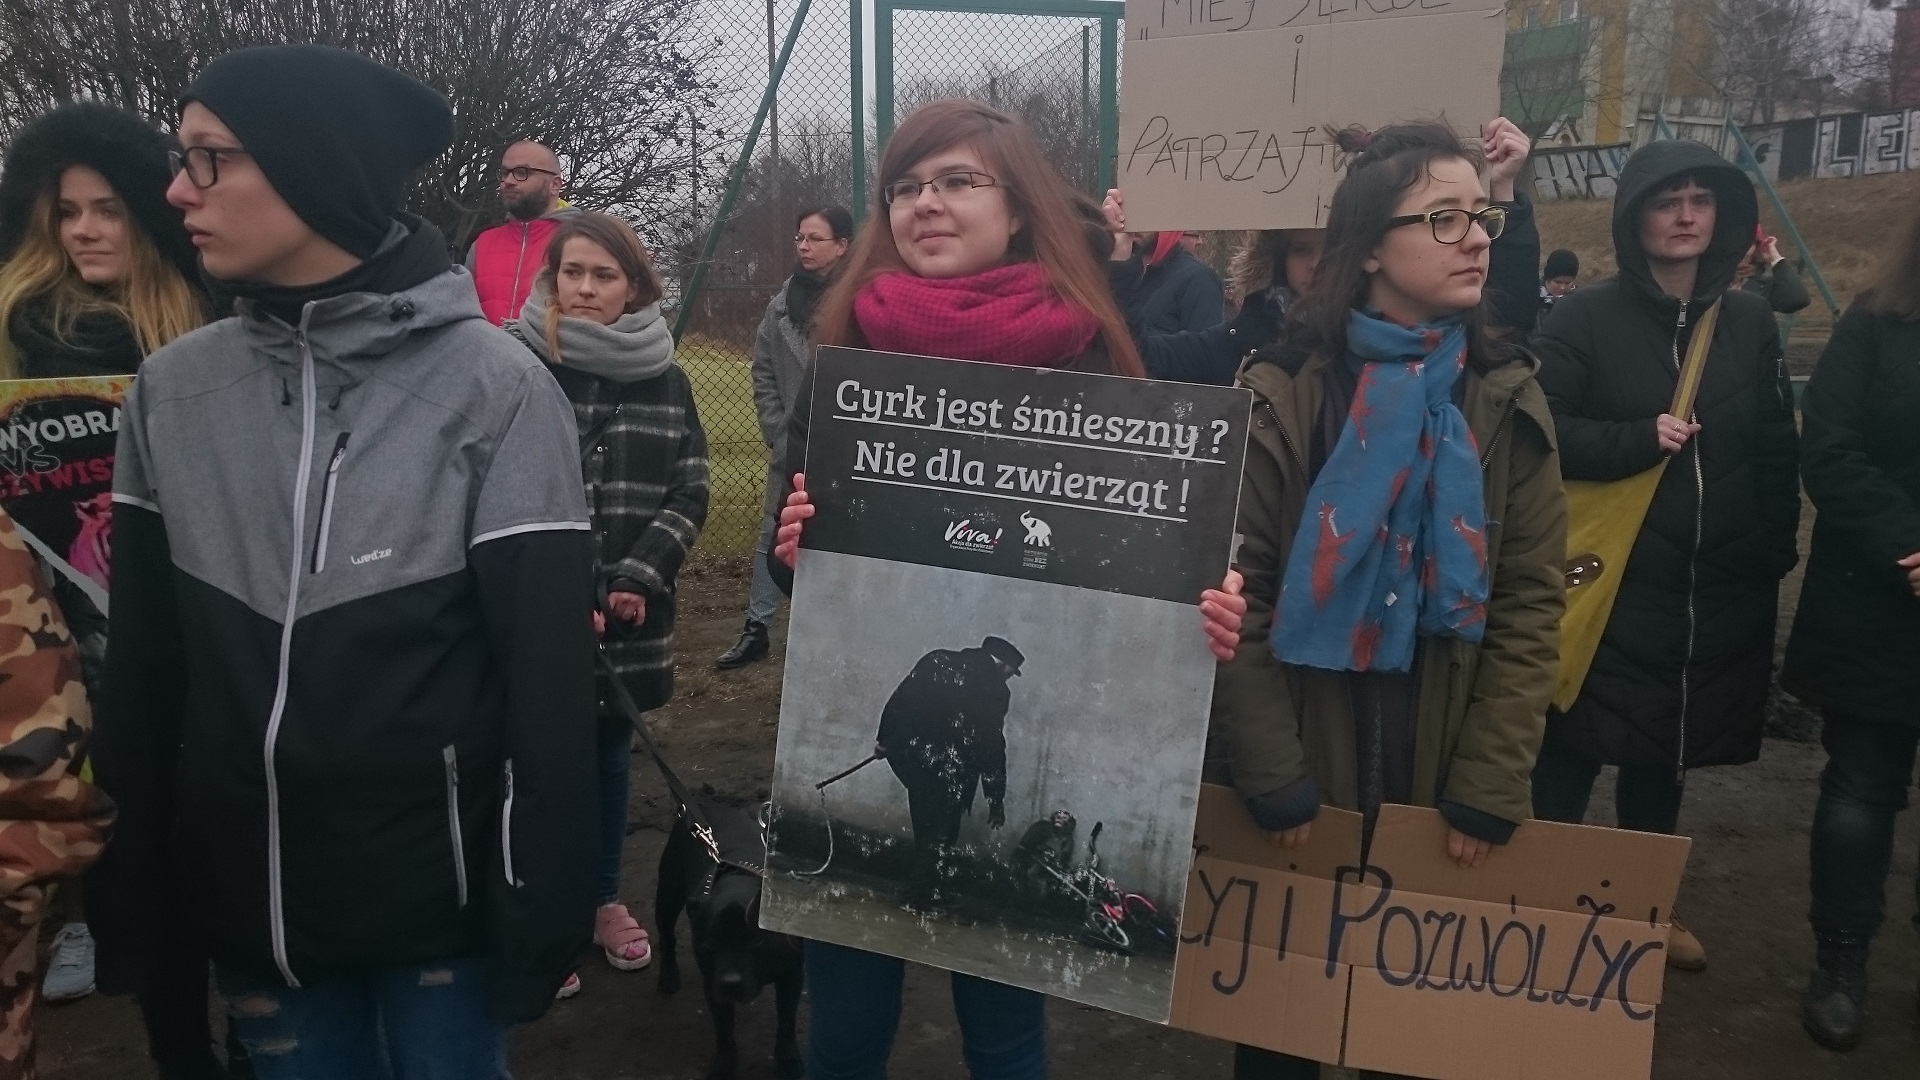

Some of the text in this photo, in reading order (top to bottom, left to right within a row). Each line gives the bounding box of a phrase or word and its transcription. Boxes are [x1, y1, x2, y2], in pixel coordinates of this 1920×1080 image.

[836, 380, 927, 421] Cyrk
[930, 388, 1004, 428] jest
[1012, 394, 1198, 457] śmieszny
[853, 440, 917, 478] Nie
[926, 448, 985, 486] dla
[995, 461, 1169, 515] zwierząt
[944, 519, 1003, 545] Viva!
